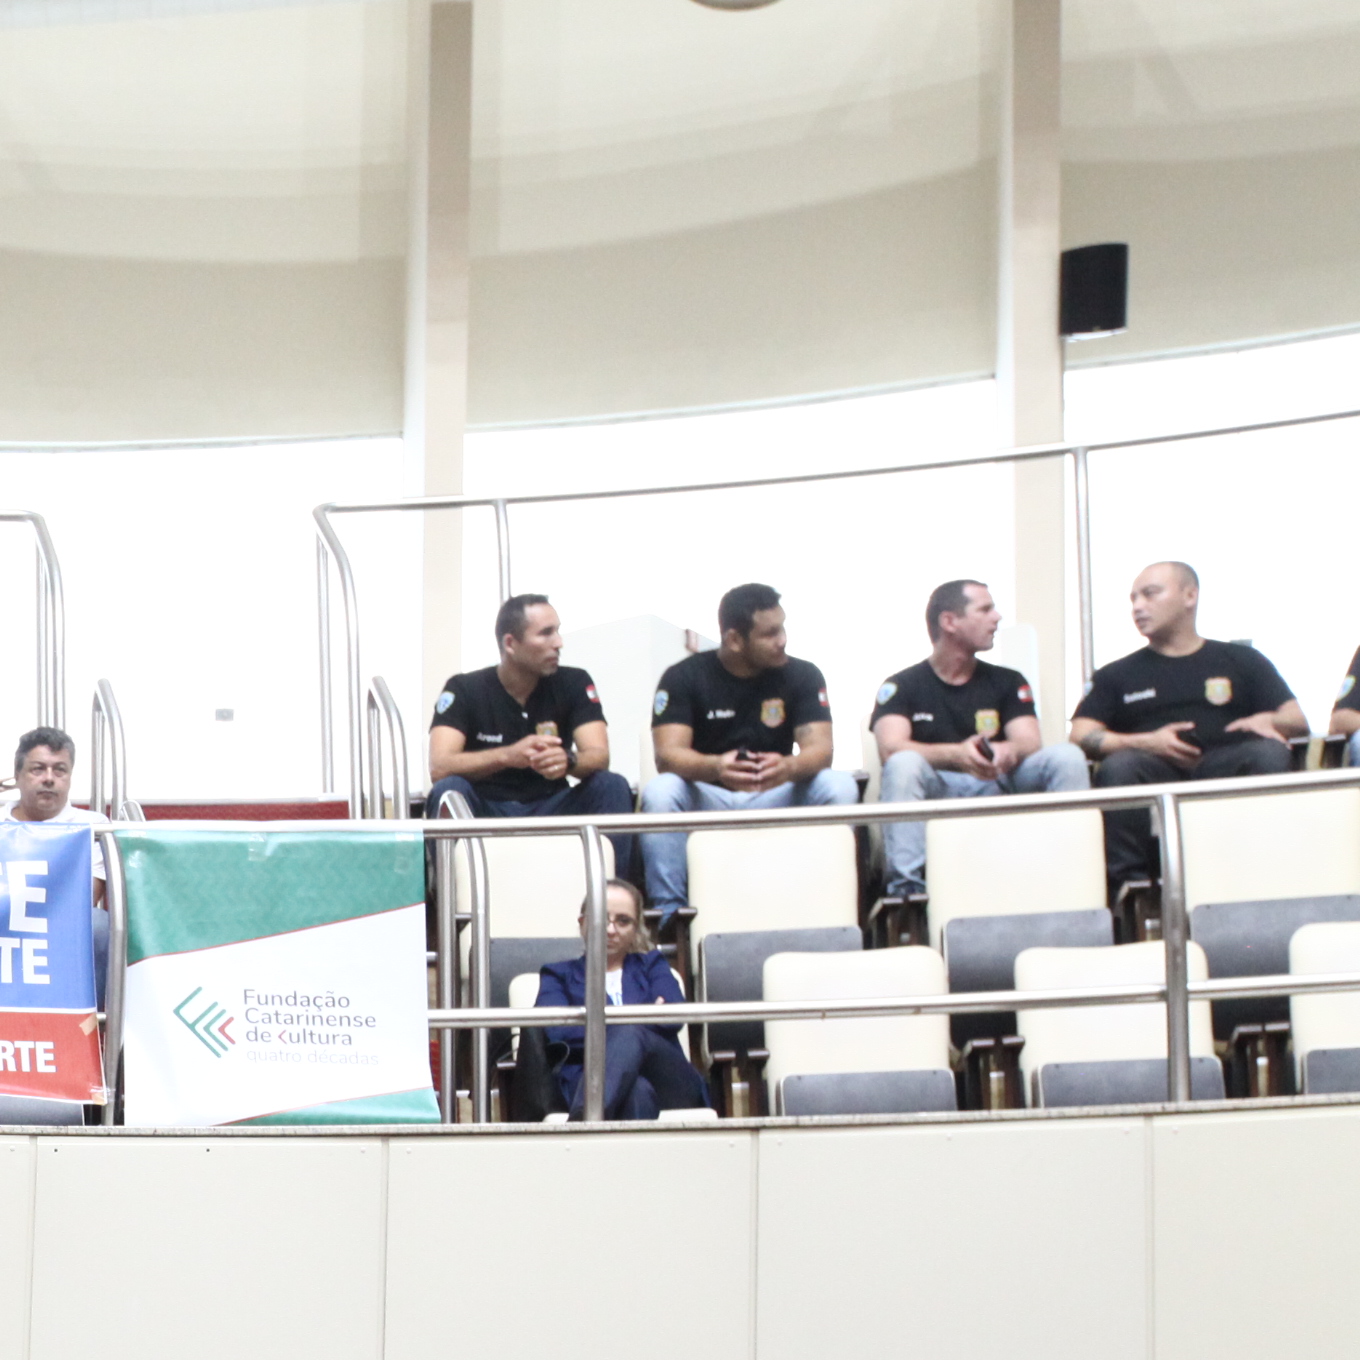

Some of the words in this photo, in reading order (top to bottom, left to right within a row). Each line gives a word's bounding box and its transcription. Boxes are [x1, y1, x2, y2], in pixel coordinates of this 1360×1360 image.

[243, 988, 351, 1012] Fundação
[245, 1007, 376, 1028] Catarinense
[245, 1026, 272, 1043] de
[246, 1050, 302, 1064] quatro
